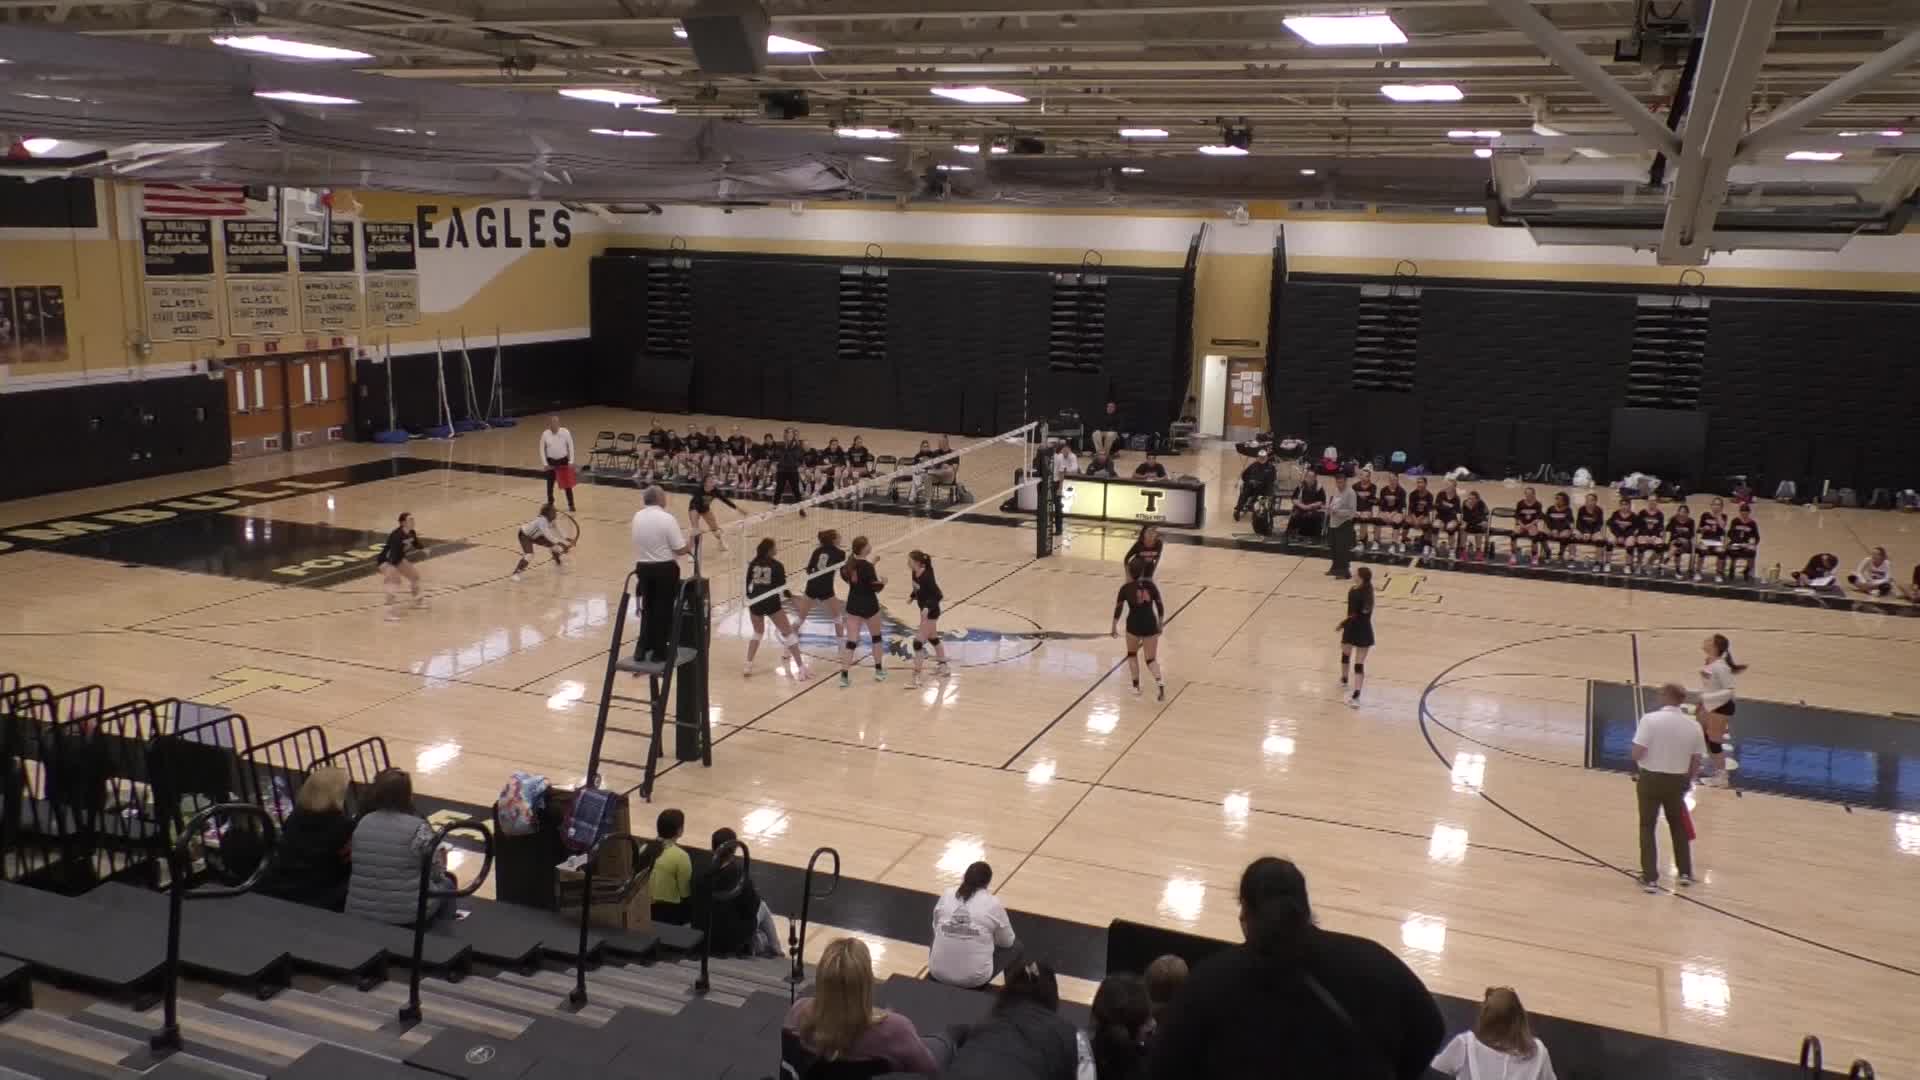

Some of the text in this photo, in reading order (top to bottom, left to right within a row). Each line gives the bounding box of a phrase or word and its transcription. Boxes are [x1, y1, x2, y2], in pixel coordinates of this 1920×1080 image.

[417, 205, 571, 248] EAGLES
[0, 481, 344, 551] MBULL
[1140, 489, 1163, 512] T
